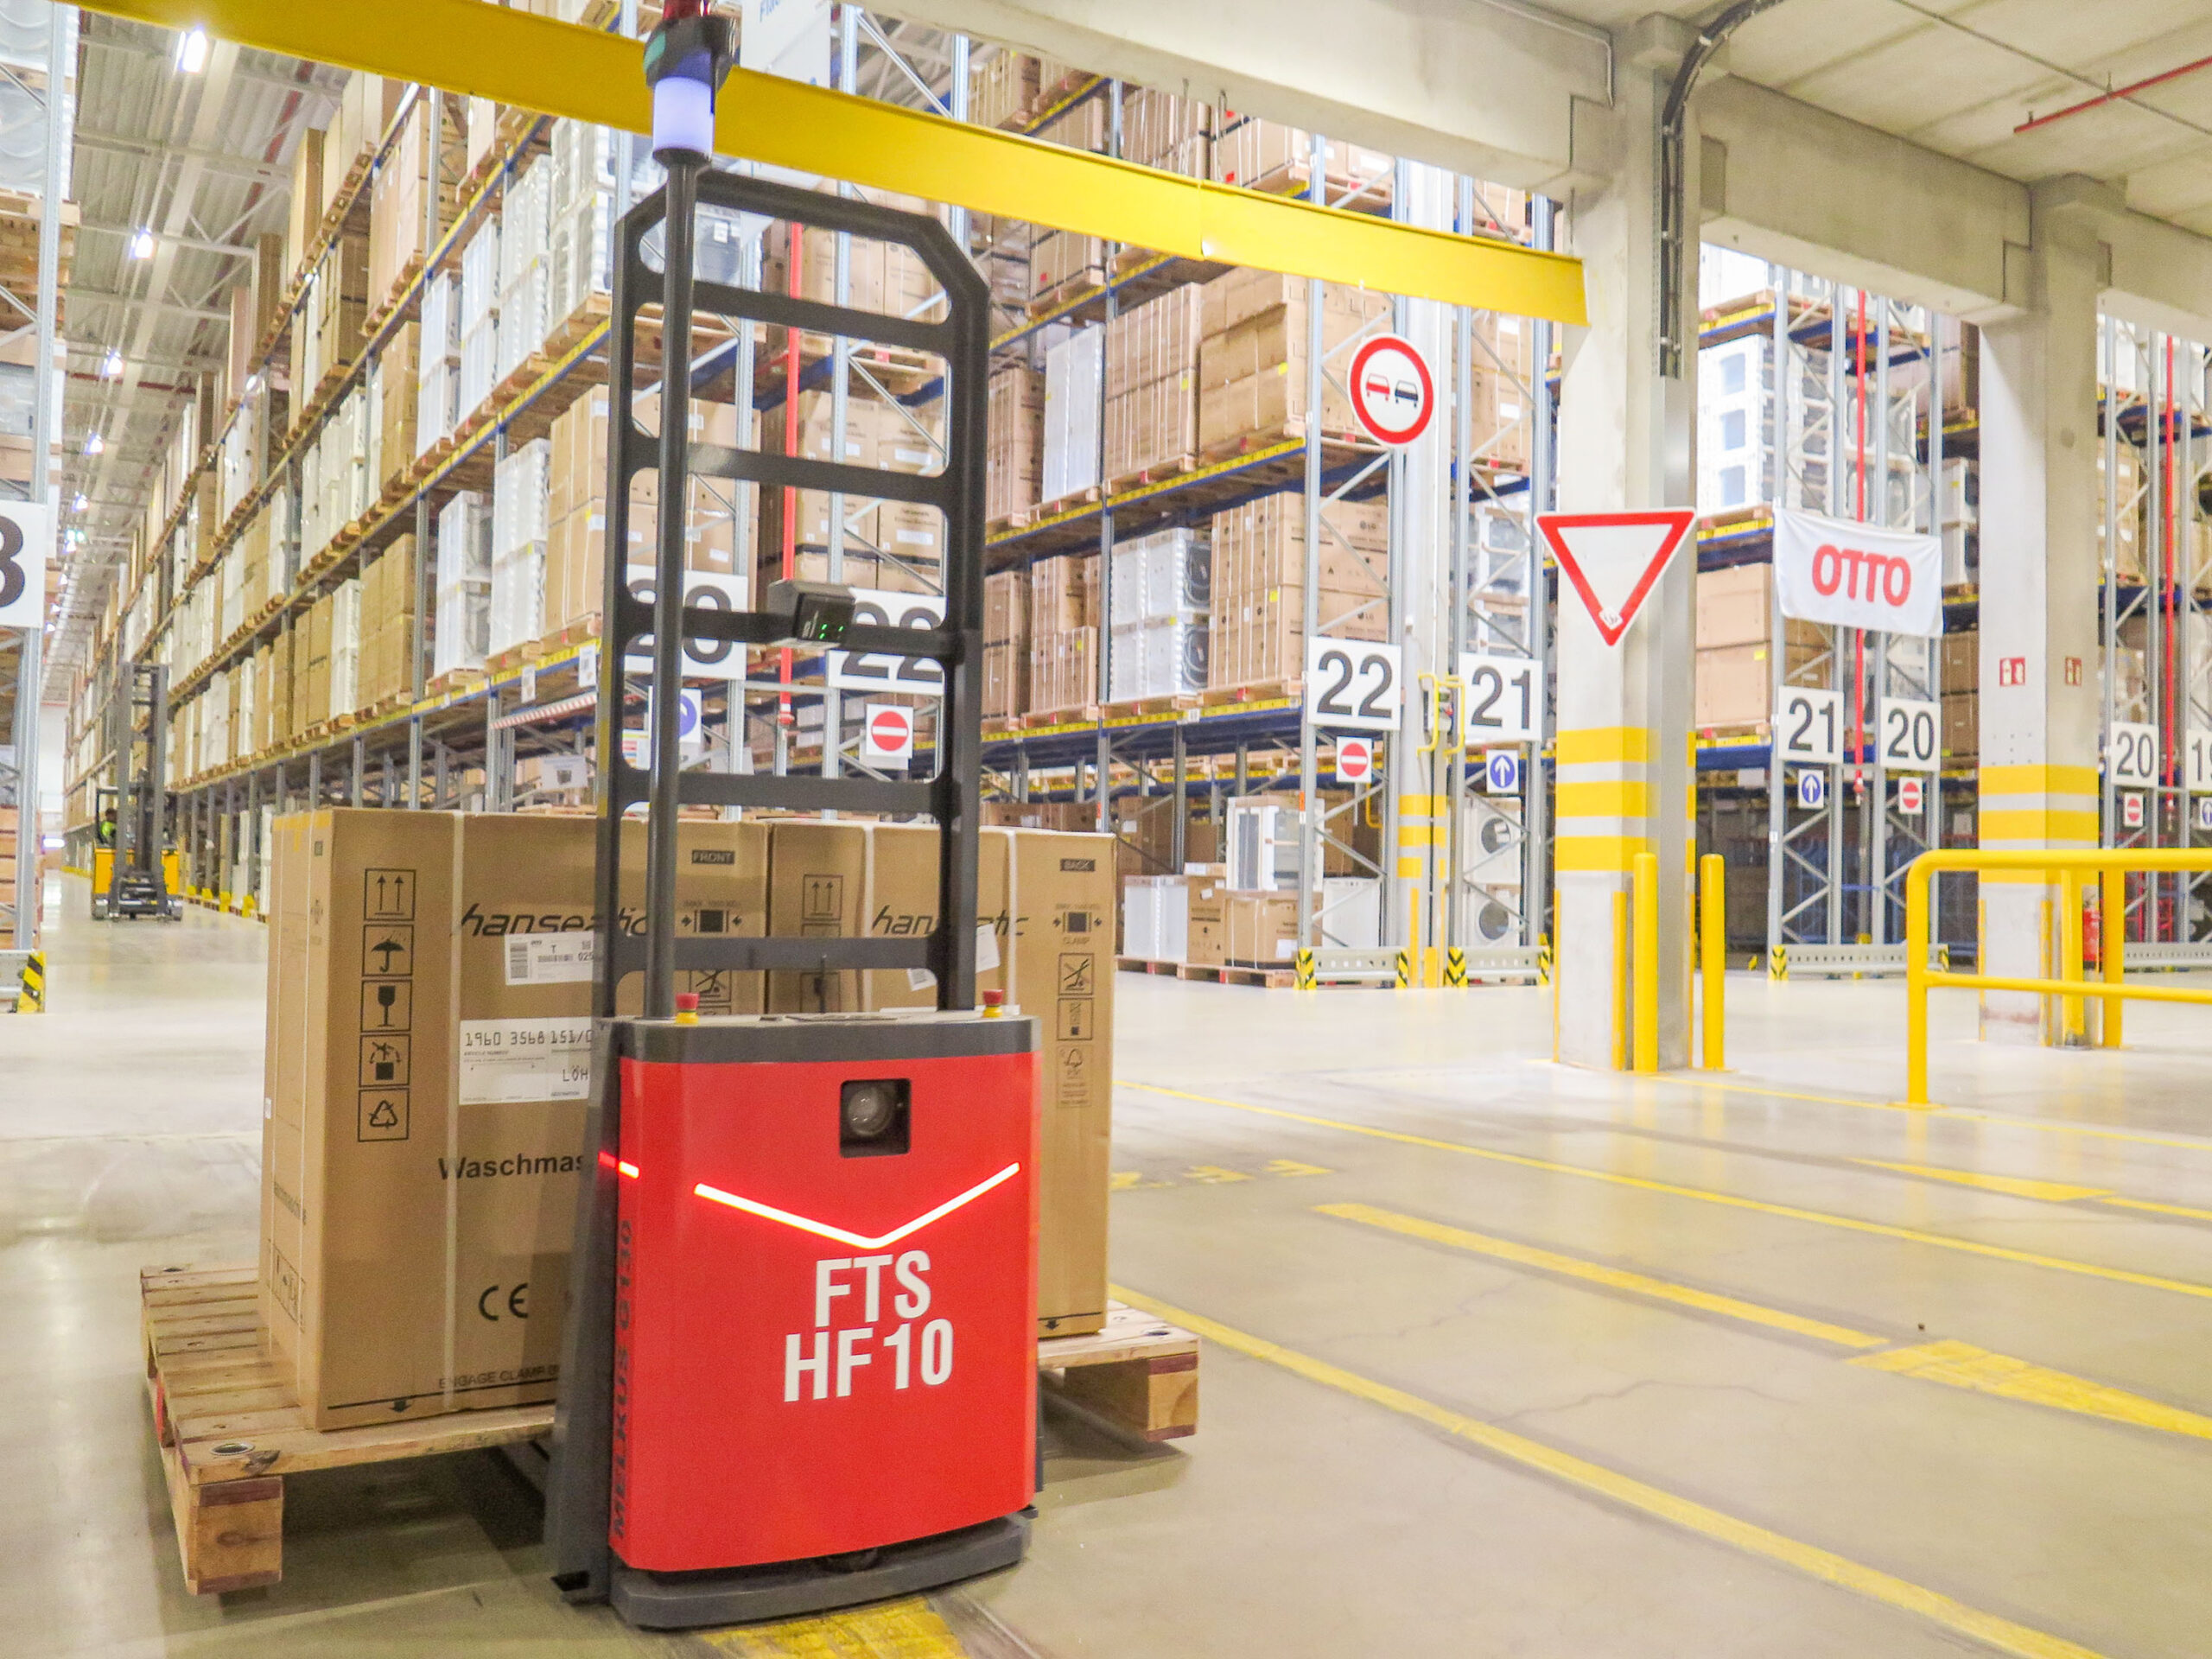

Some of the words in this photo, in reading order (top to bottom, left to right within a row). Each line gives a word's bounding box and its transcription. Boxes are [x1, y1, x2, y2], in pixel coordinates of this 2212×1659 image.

[1811, 543, 1912, 607] OTTO
[1317, 649, 1393, 719] 22
[1471, 664, 1531, 730] 21
[1788, 697, 1834, 753] 21
[1887, 708, 1935, 761] 20
[2116, 730, 2155, 779] 20
[2191, 737, 2212, 782] 1
[693, 851, 733, 863] FRONT
[872, 905, 1030, 936] hantic
[465, 1031, 502, 1047] 1960
[511, 1030, 545, 1046] 3568
[478, 1282, 529, 1321] CE
[815, 1249, 932, 1328] FTS
[438, 1370, 497, 1389] EGAGE
[784, 1318, 954, 1402] HF10
